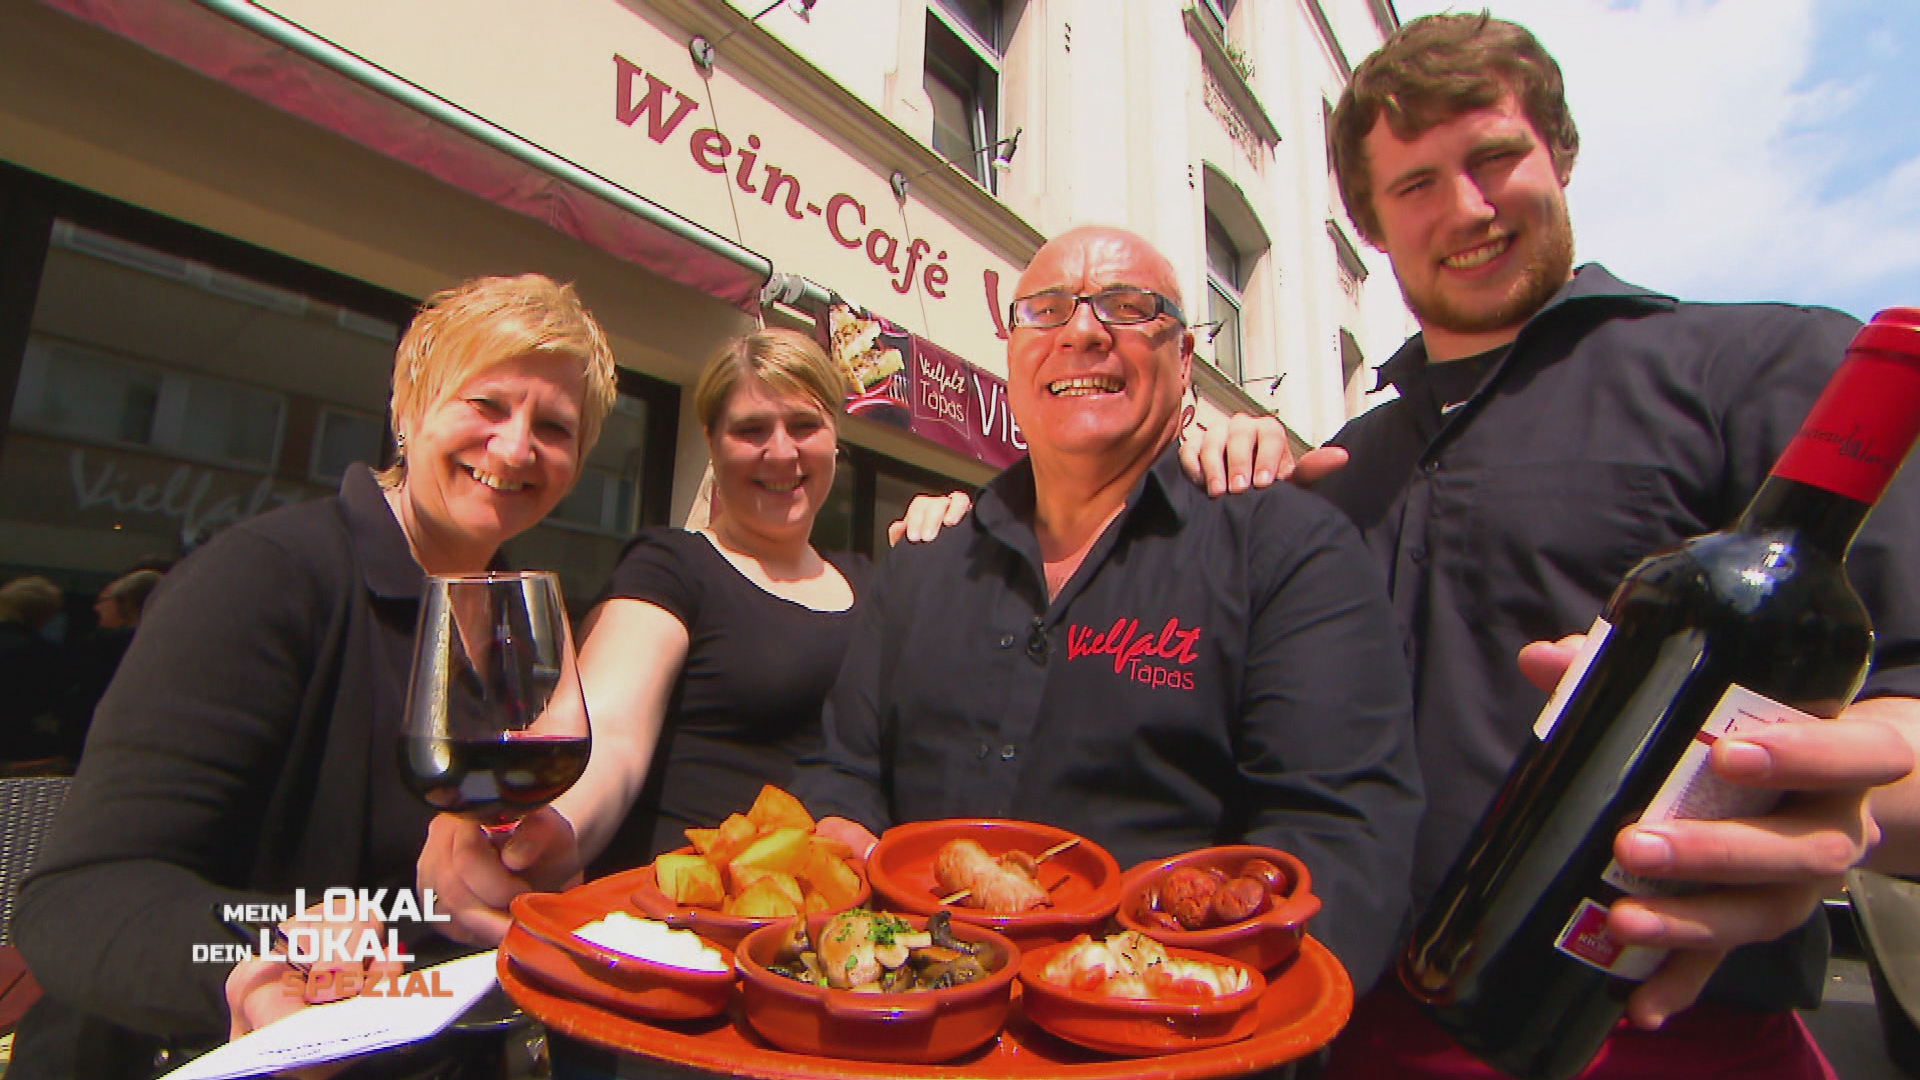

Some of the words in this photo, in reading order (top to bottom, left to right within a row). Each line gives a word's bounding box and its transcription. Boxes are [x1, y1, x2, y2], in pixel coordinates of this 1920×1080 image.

[613, 52, 949, 299] Wein-Café
[919, 352, 966, 394] Vielfalt
[920, 379, 964, 422] Tapas
[1067, 616, 1201, 674] Vielfalt
[1129, 658, 1195, 690] Tapas
